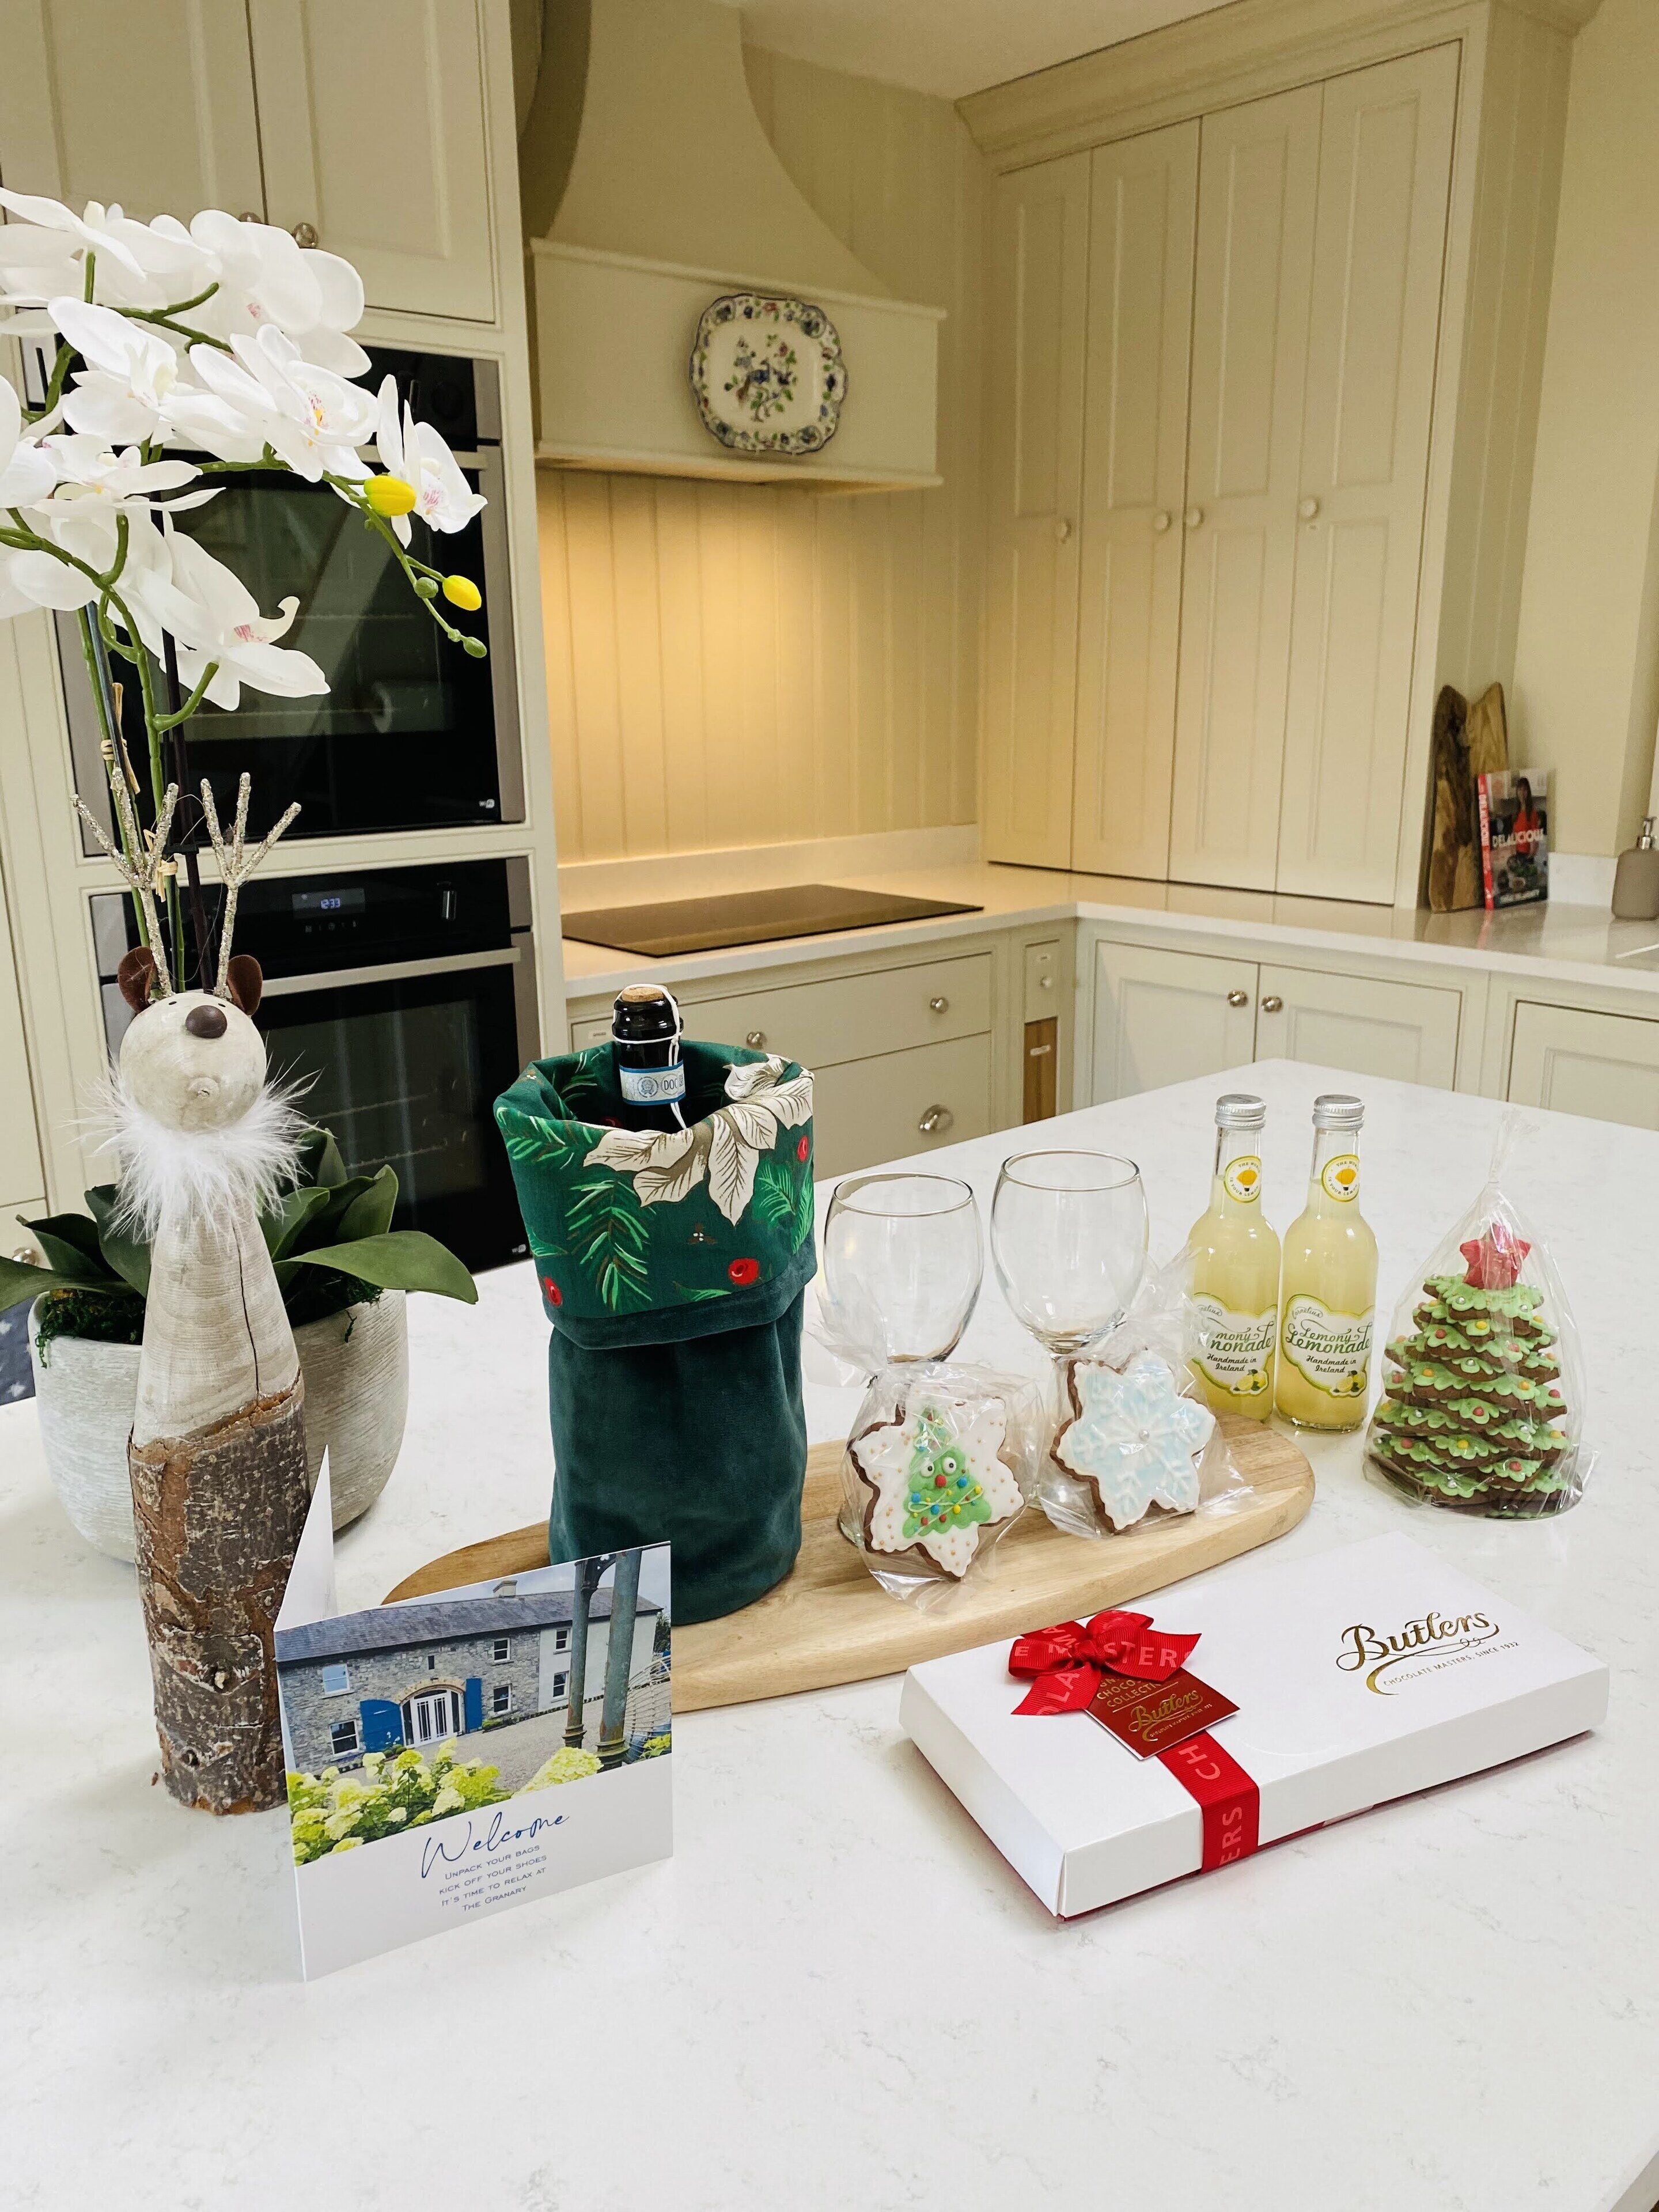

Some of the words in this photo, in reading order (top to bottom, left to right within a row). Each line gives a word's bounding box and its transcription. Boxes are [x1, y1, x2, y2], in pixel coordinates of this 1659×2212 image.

[1215, 1328, 1259, 1343] mony
[1286, 1323, 1372, 1354] Lemonade
[1300, 1324, 1359, 1344] Lemony
[1207, 1353, 1249, 1364] Handmade
[1215, 1363, 1246, 1372] Ireland
[1306, 1355, 1349, 1365] Handmade
[1314, 1365, 1346, 1373] Ireland
[1336, 1612, 1499, 1673] Butlers
[1383, 1666, 1433, 1686] CHOCOLATE
[1476, 1646, 1499, 1658] SINCE
[1500, 1641, 1519, 1651] 1932
[1096, 1679, 1137, 1700] CHOCO
[1106, 1682, 1157, 1707] COLLECTI
[1129, 1690, 1203, 1733] Butlers
[421, 1811, 570, 1878] Welcome
[486, 1854, 512, 1866] YOUR
[516, 1844, 540, 1858] BAGS
[439, 1883, 460, 1895] KICK
[464, 1876, 483, 1887] OFF
[486, 1866, 512, 1879] YOUR
[516, 1855, 547, 1870] SHOES
[441, 1896, 460, 1907] IT'S
[463, 1887, 484, 1899] TIME
[488, 1883, 501, 1892] TO
[504, 1873, 533, 1886] RELAX
[536, 1868, 547, 1877] AT
